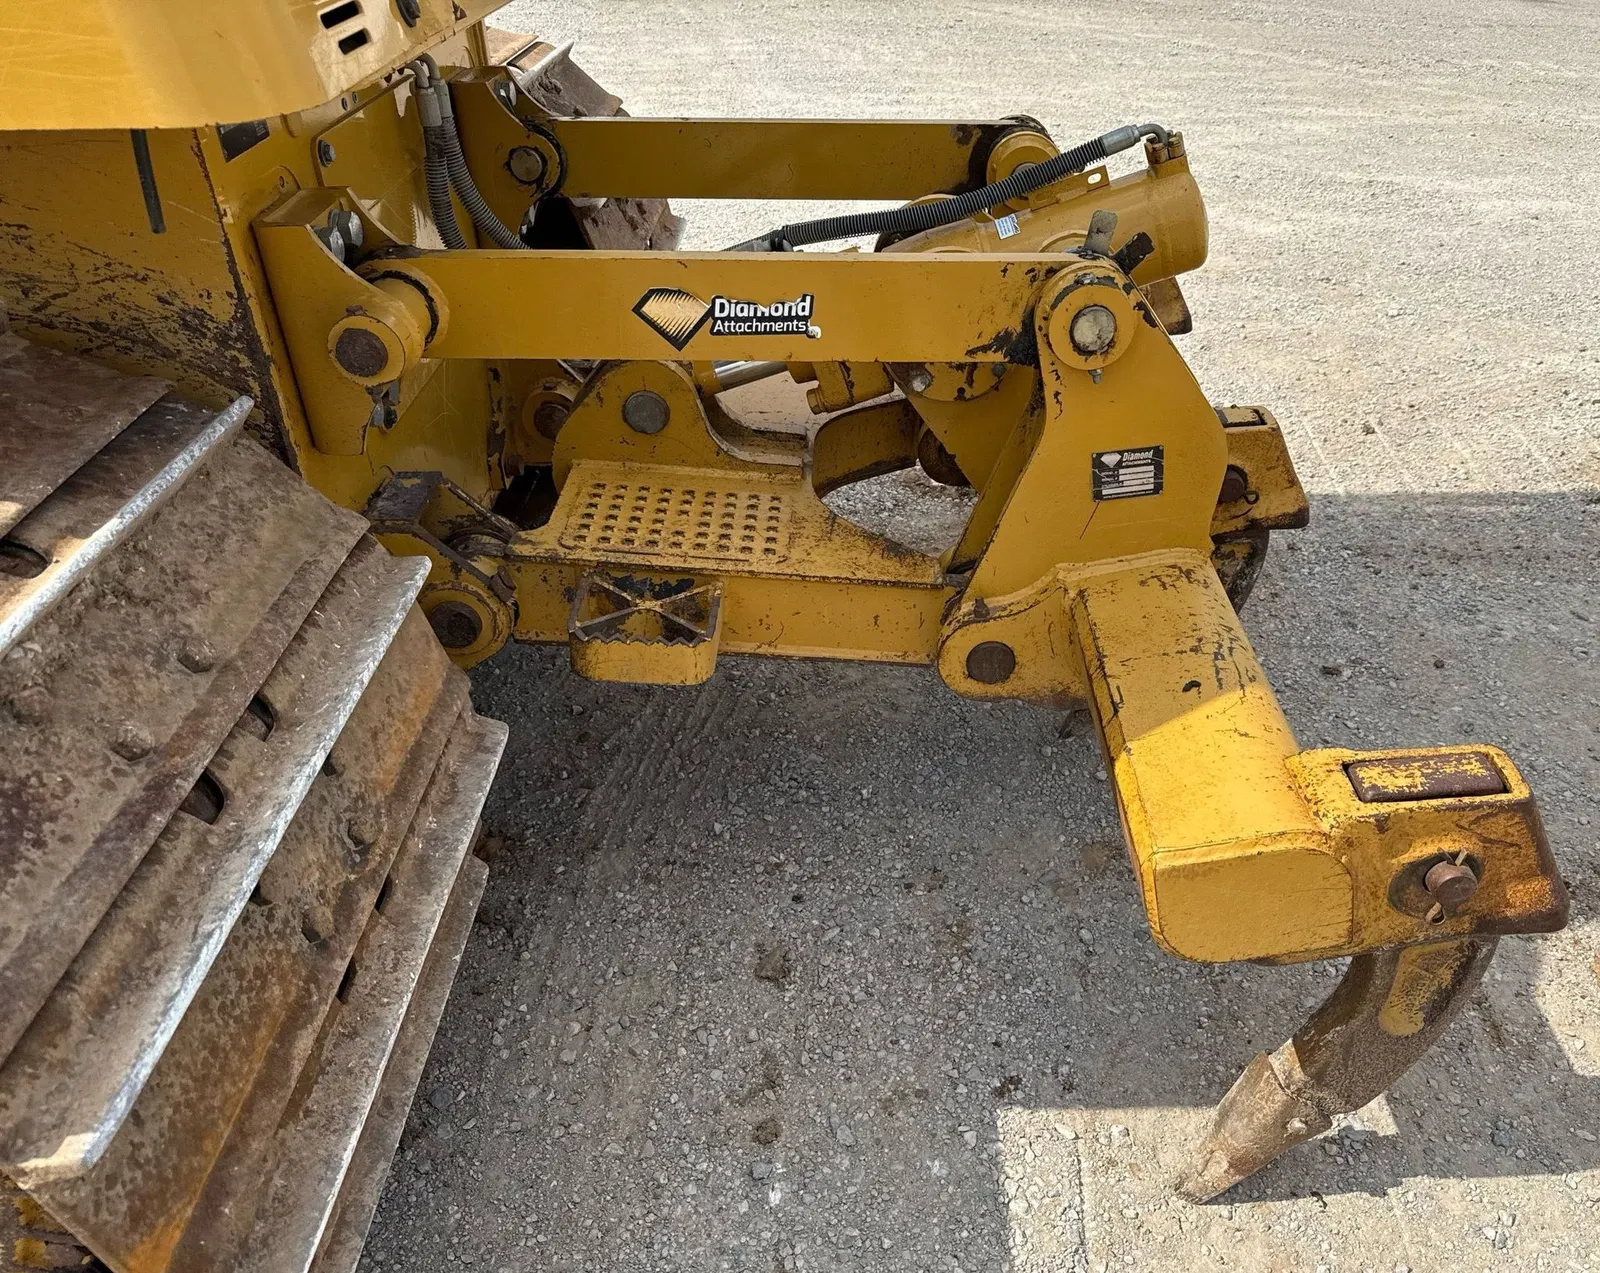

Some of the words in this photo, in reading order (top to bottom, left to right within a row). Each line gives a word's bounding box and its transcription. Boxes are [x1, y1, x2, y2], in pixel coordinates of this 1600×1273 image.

[714, 295, 811, 317] Diamond
[713, 318, 807, 333] Attachments
[1123, 449, 1154, 461] Diamond
